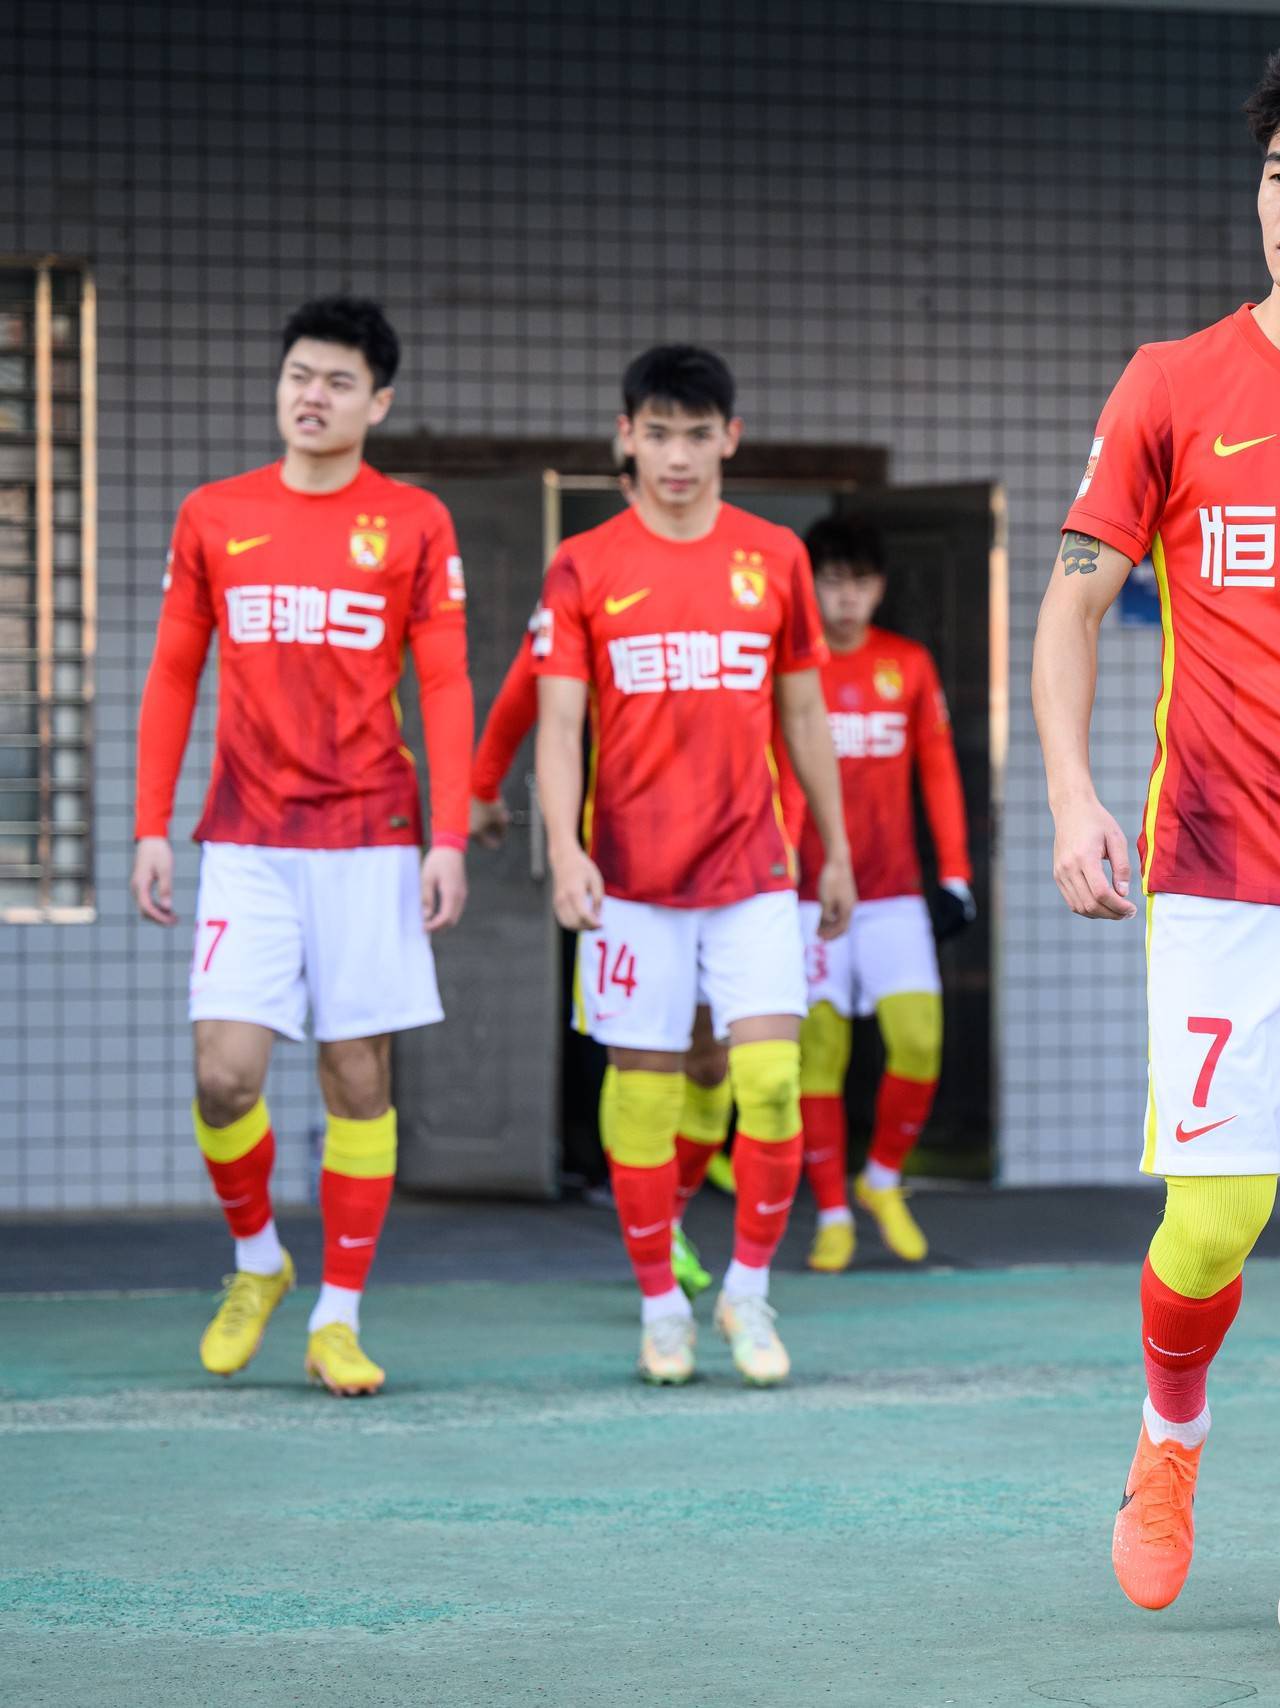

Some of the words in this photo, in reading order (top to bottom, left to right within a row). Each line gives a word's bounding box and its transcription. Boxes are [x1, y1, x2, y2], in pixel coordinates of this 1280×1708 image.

[225, 584, 387, 651] 恒驰5
[608, 631, 772, 695] 恒驰5
[596, 941, 637, 997] 14
[1187, 1016, 1233, 1108] 7
